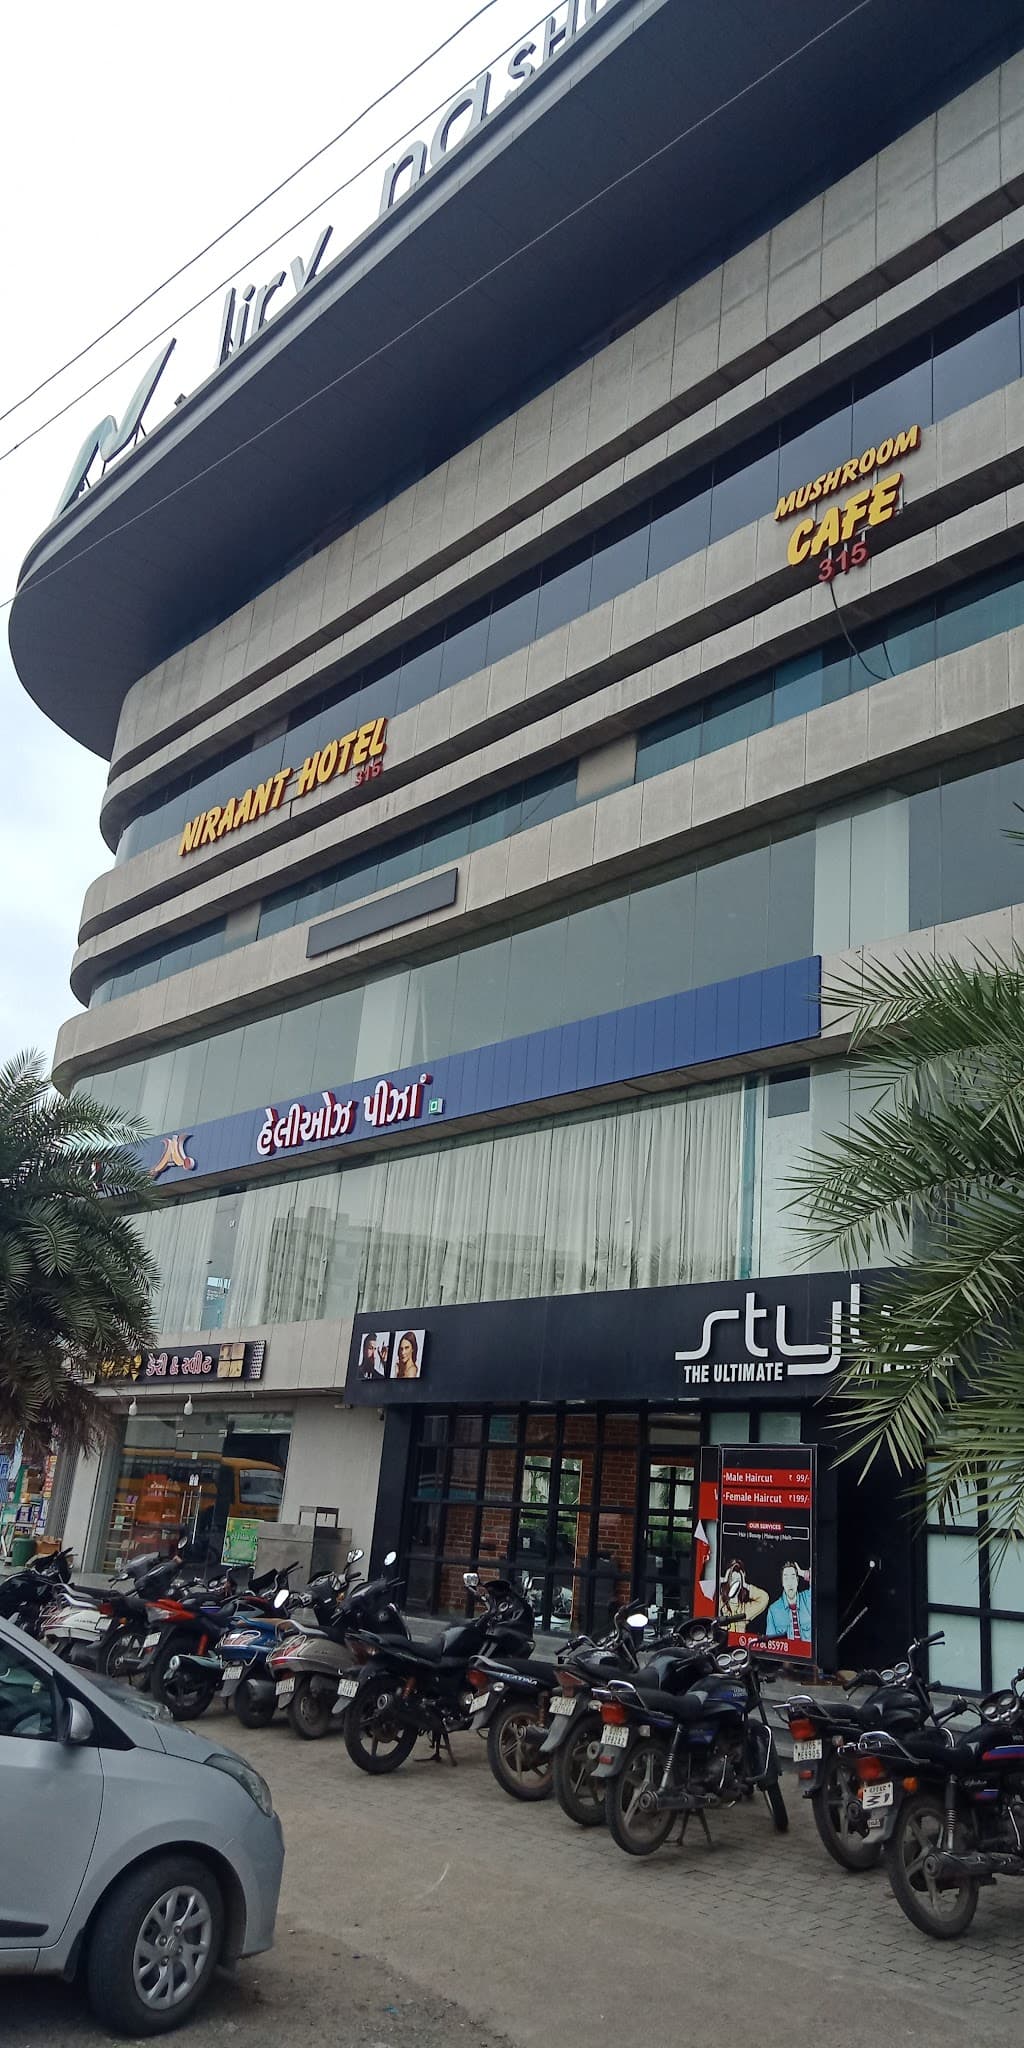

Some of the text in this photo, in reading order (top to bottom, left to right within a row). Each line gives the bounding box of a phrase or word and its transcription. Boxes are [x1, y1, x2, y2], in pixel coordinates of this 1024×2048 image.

[774, 424, 921, 522] MUSHROOM
[787, 471, 903, 567] CAFE
[818, 541, 868, 583] 315
[178, 717, 388, 857] NIRAANT HOTEL
[684, 1361, 784, 1383] THE ULTIMATE
[725, 1472, 743, 1482] Male
[745, 1473, 773, 1483] Haircut
[725, 1491, 752, 1502] Female
[753, 1493, 782, 1504] Haircut
